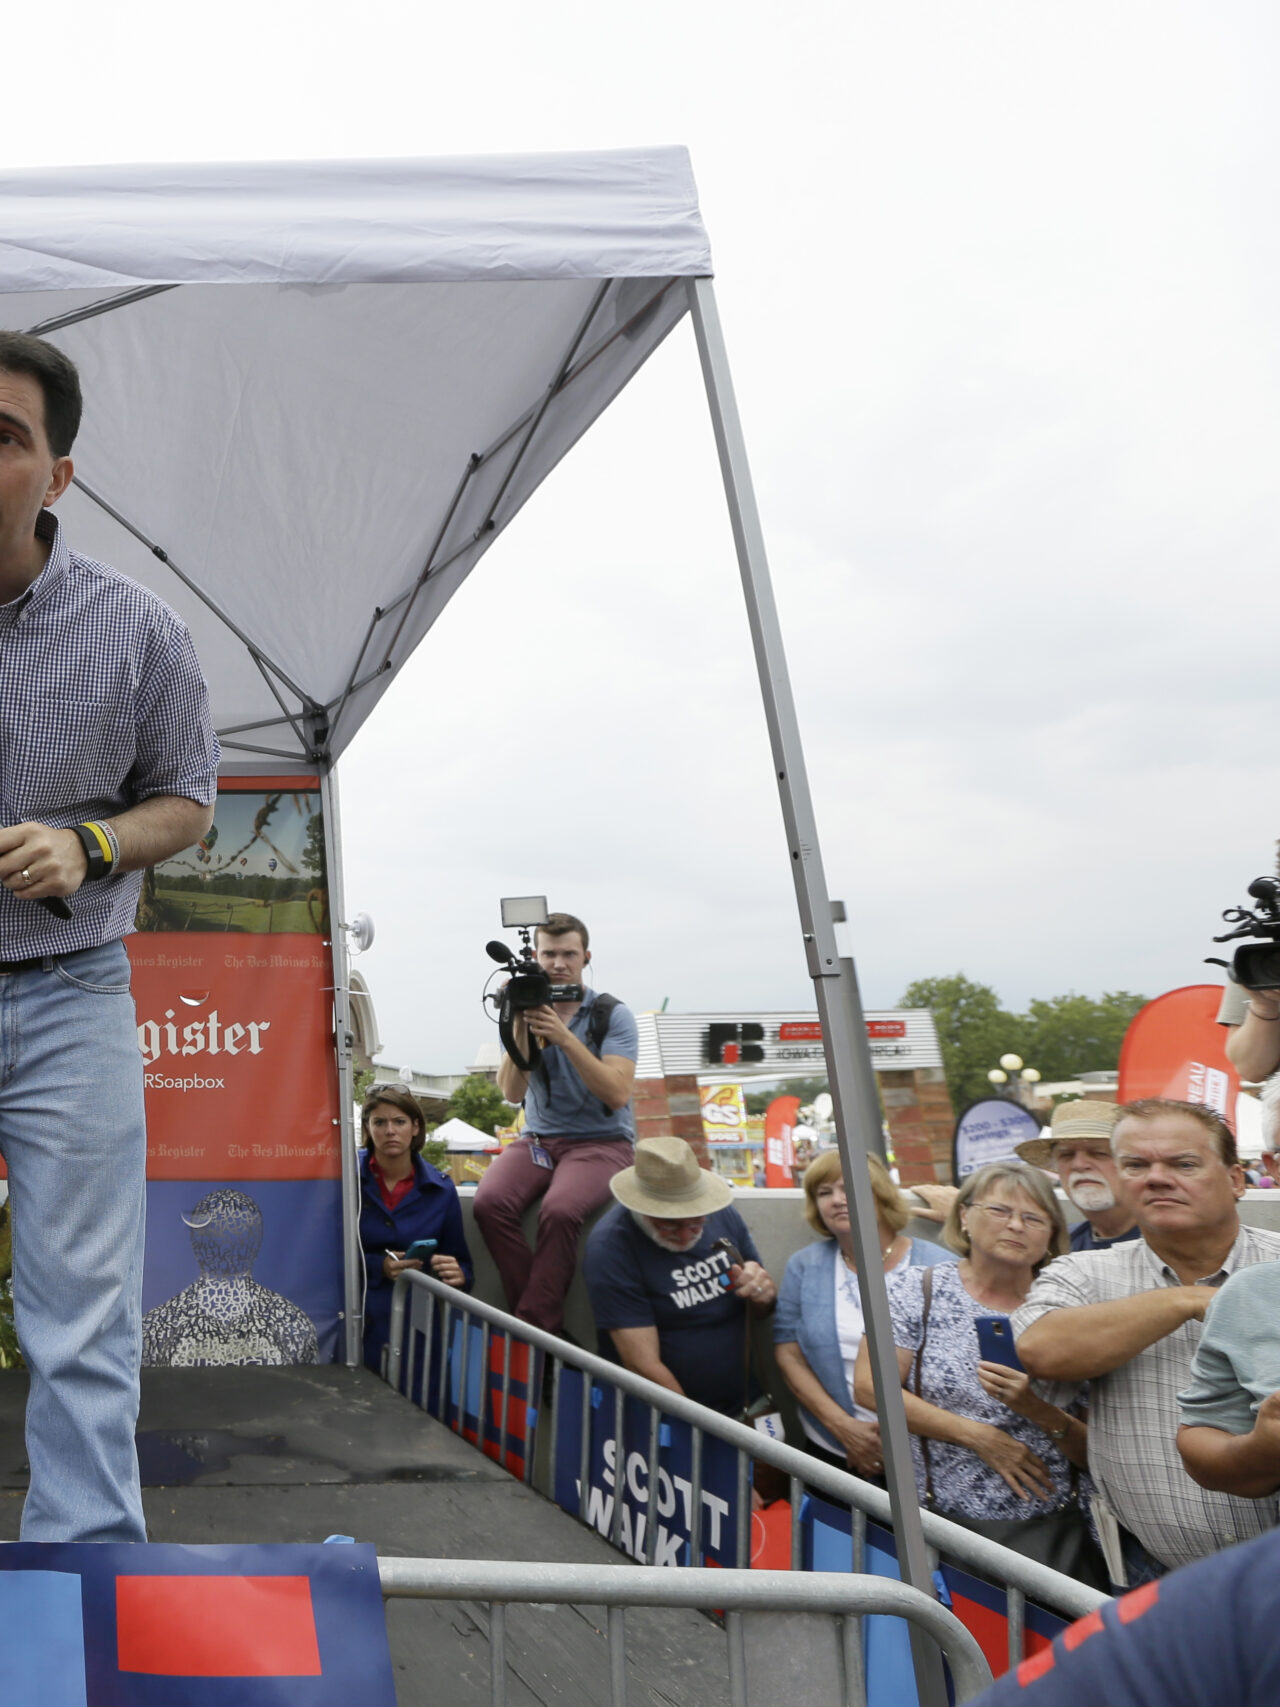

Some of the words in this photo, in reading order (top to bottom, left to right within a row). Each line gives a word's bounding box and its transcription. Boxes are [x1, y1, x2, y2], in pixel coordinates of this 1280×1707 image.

[156, 955, 205, 969] Register
[224, 955, 245, 969] The
[247, 955, 268, 968] Des
[269, 955, 310, 968] Moines
[136, 1008, 271, 1066] gister
[144, 1073, 225, 1092] RSoapbox
[1188, 1061, 1206, 1103] REAU
[701, 1103, 741, 1127] GS
[157, 1143, 206, 1160] Register
[227, 1143, 249, 1158] The
[252, 1143, 273, 1157] Des
[274, 1143, 316, 1158] Moines
[671, 1251, 731, 1287] SCOTT
[670, 1278, 727, 1309] WALK
[602, 1438, 729, 1550] SCOTT
[575, 1478, 685, 1567] WALK
